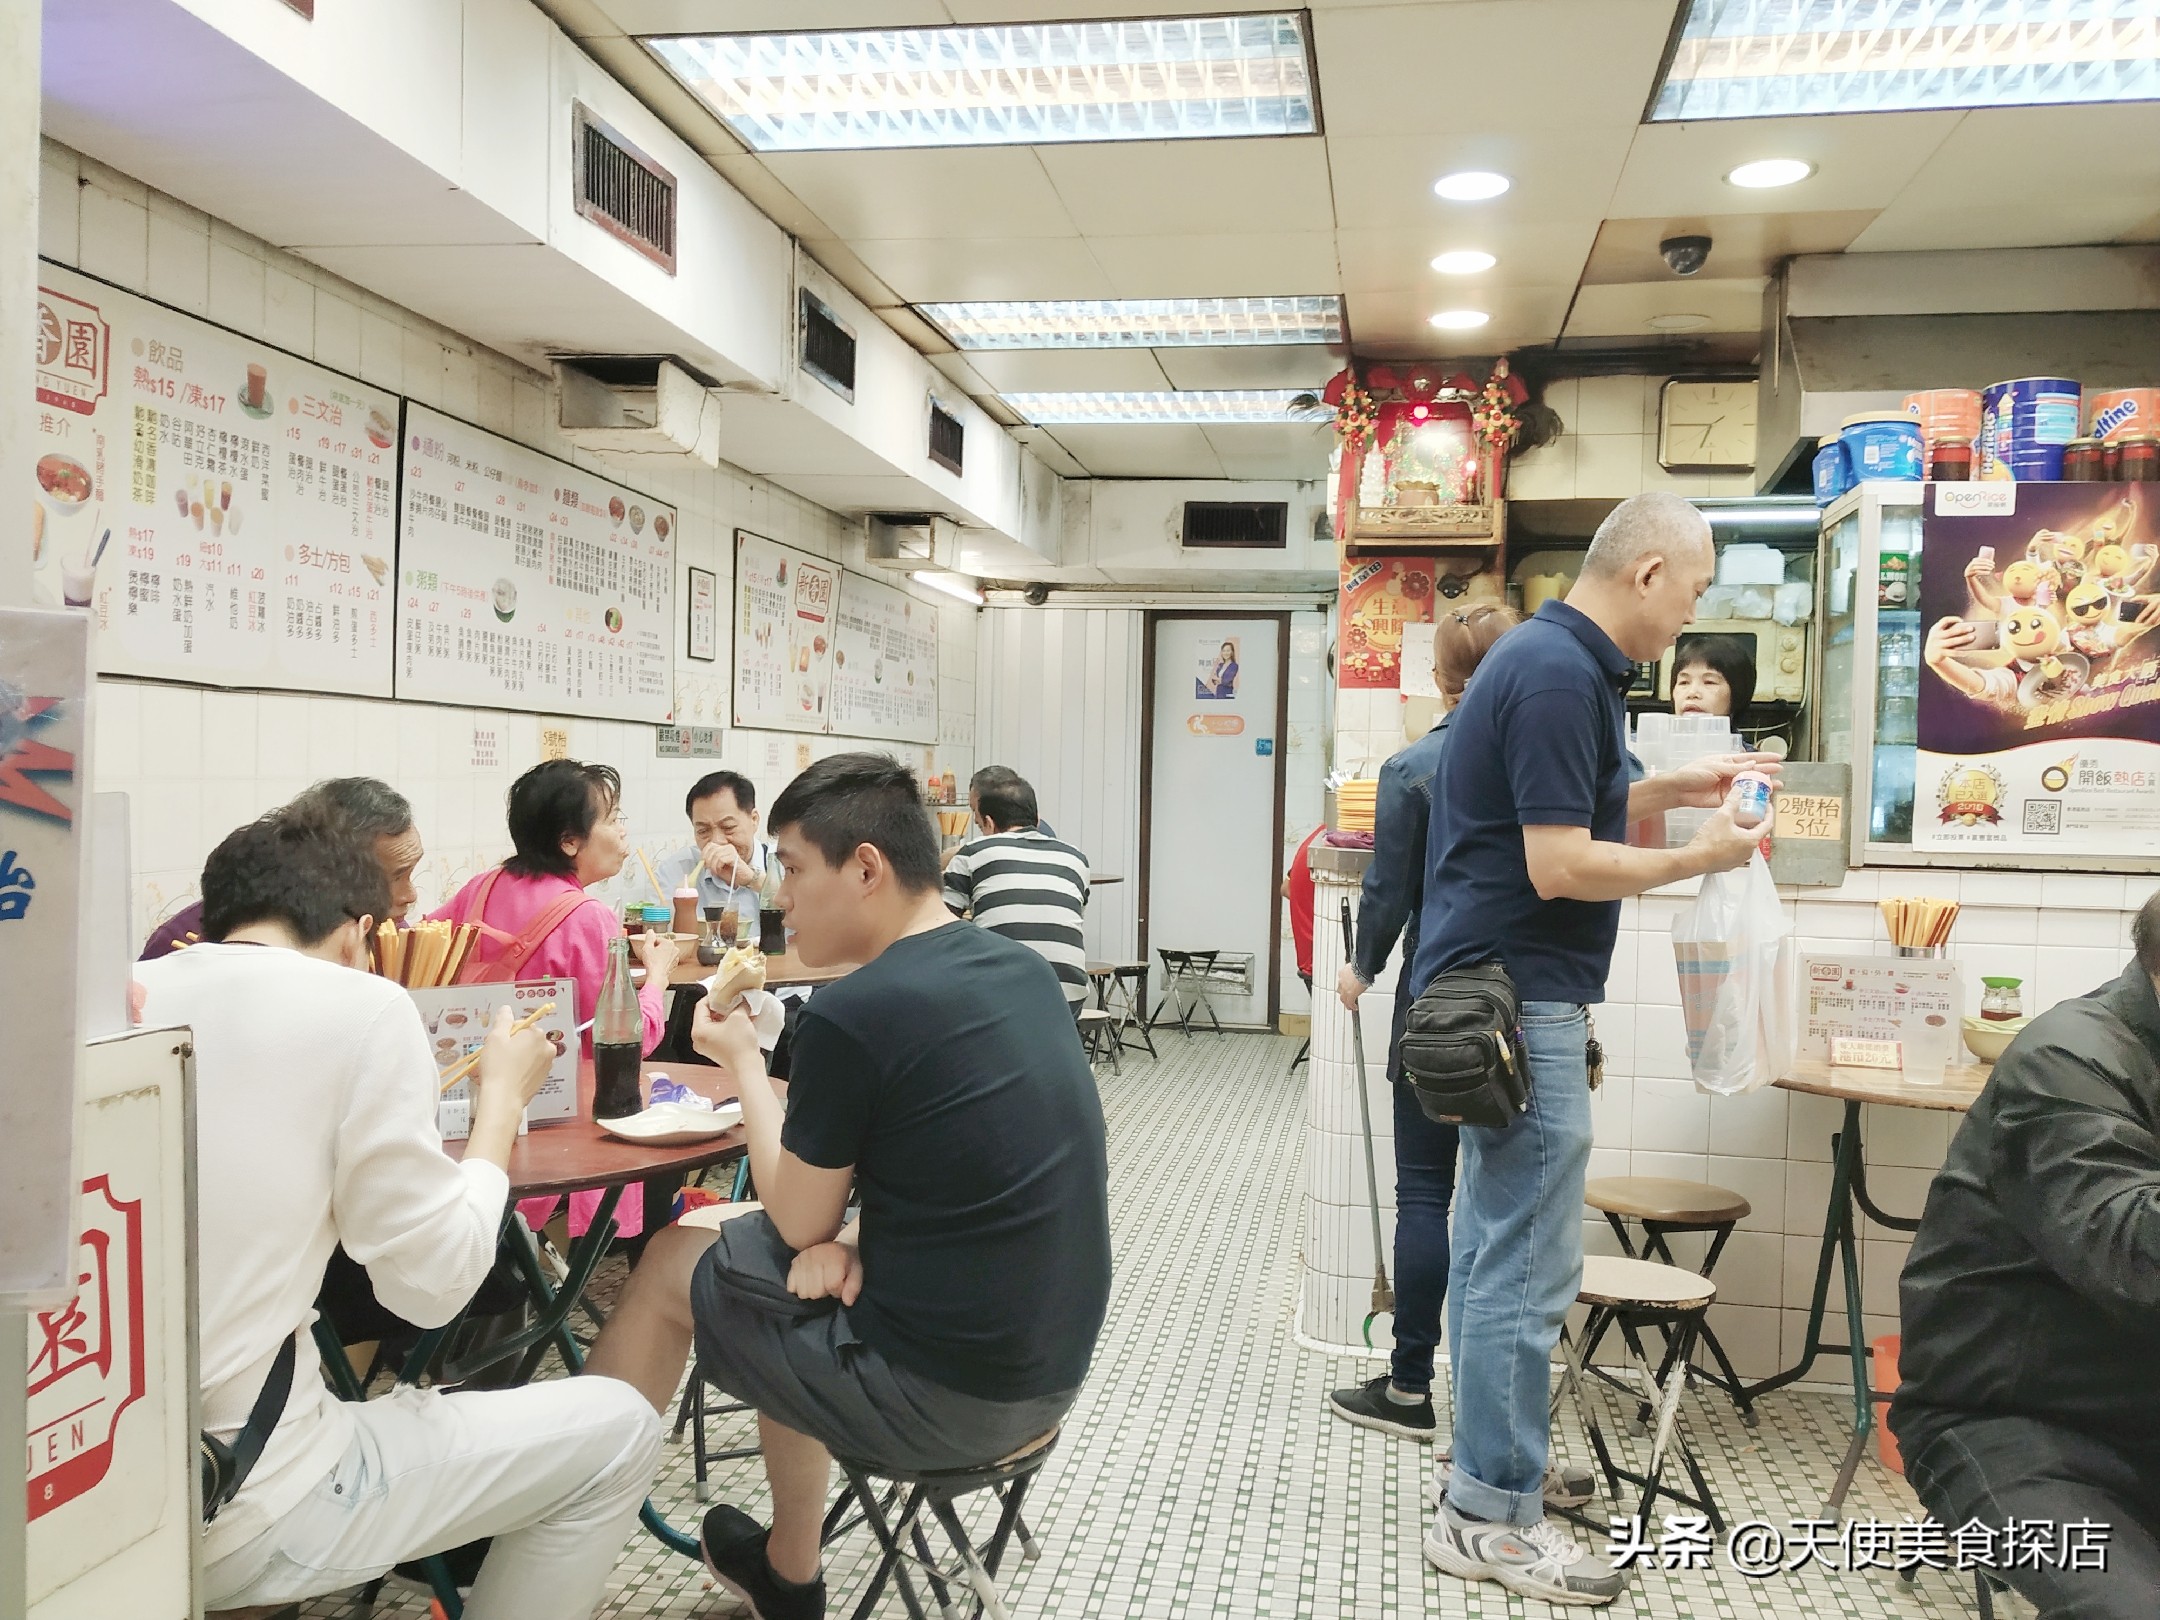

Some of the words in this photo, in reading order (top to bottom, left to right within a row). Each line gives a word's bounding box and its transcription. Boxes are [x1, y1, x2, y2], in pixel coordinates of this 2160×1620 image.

[148, 339, 184, 374] 飲品
[39, 412, 72, 438] 推介
[302, 394, 343, 427] 三文治
[183, 420, 194, 466] 阿華田
[194, 424, 206, 470] 好立克
[1982, 406, 1997, 474] Horlicks
[1944, 490, 2007, 504] OpenRice
[298, 543, 351, 574] 多士/方包
[1959, 778, 1986, 790] 本店
[1779, 797, 1840, 819] 2號枱
[1794, 818, 1830, 837] 5位
